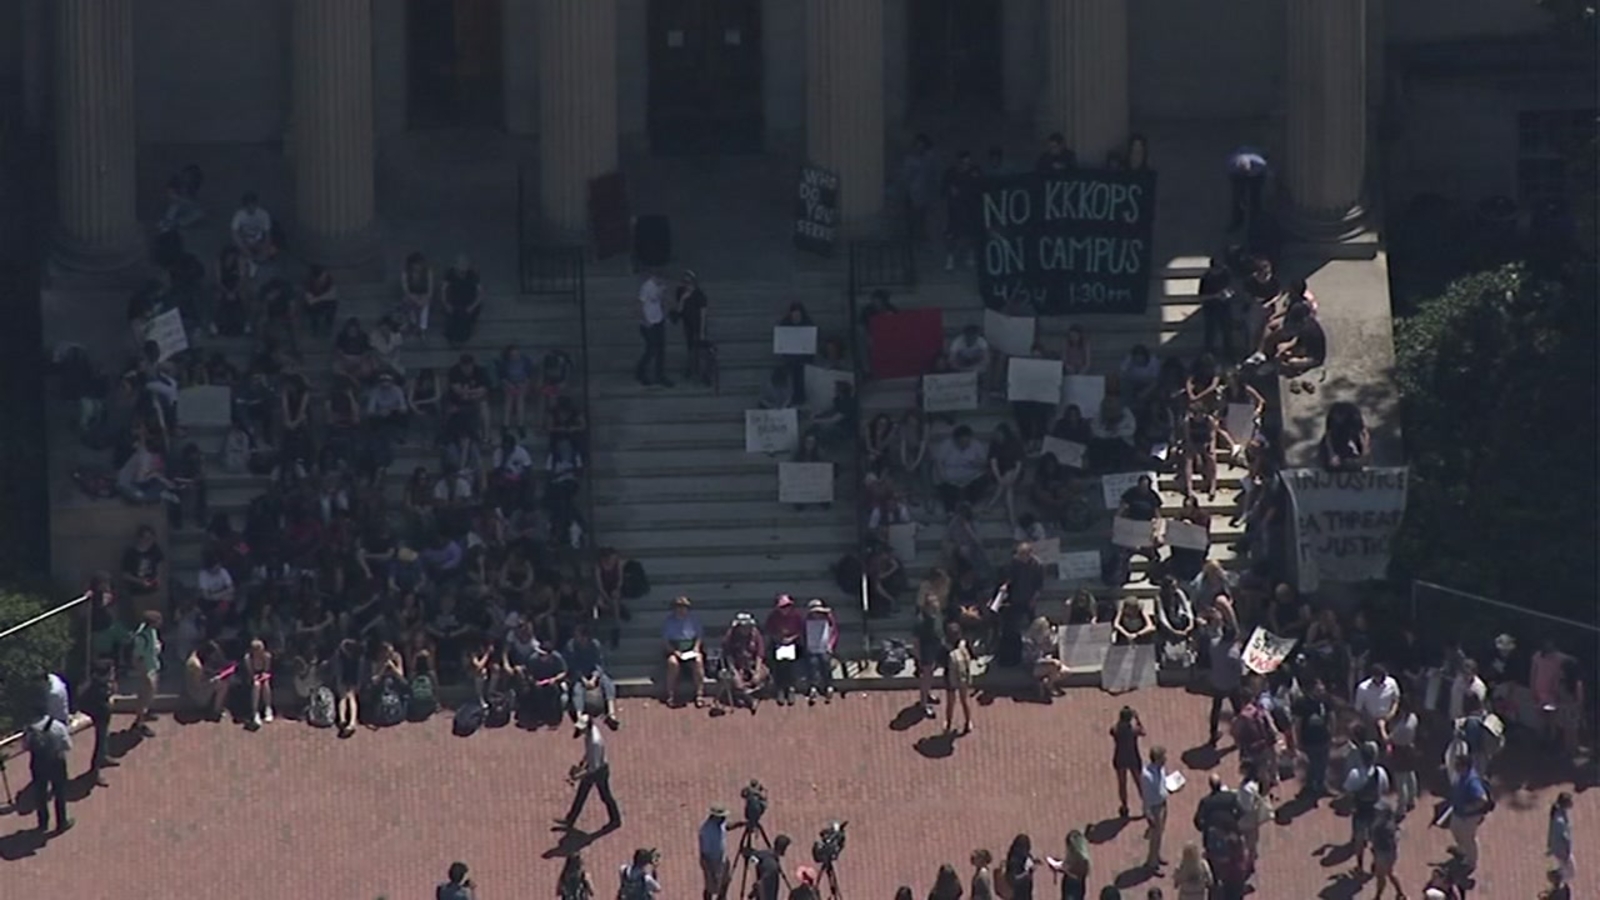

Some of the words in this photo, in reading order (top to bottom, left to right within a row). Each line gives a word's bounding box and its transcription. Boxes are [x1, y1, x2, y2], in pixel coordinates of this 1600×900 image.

[799, 182, 820, 201] DO
[982, 189, 1031, 228] NO
[1044, 179, 1143, 223] KKKOPS
[986, 236, 1026, 275] ON
[1039, 236, 1144, 274] CAMPUS
[1294, 471, 1404, 491] INJUSTICE
[1322, 509, 1402, 531] THREAT
[1317, 534, 1390, 558] JUSTIC
